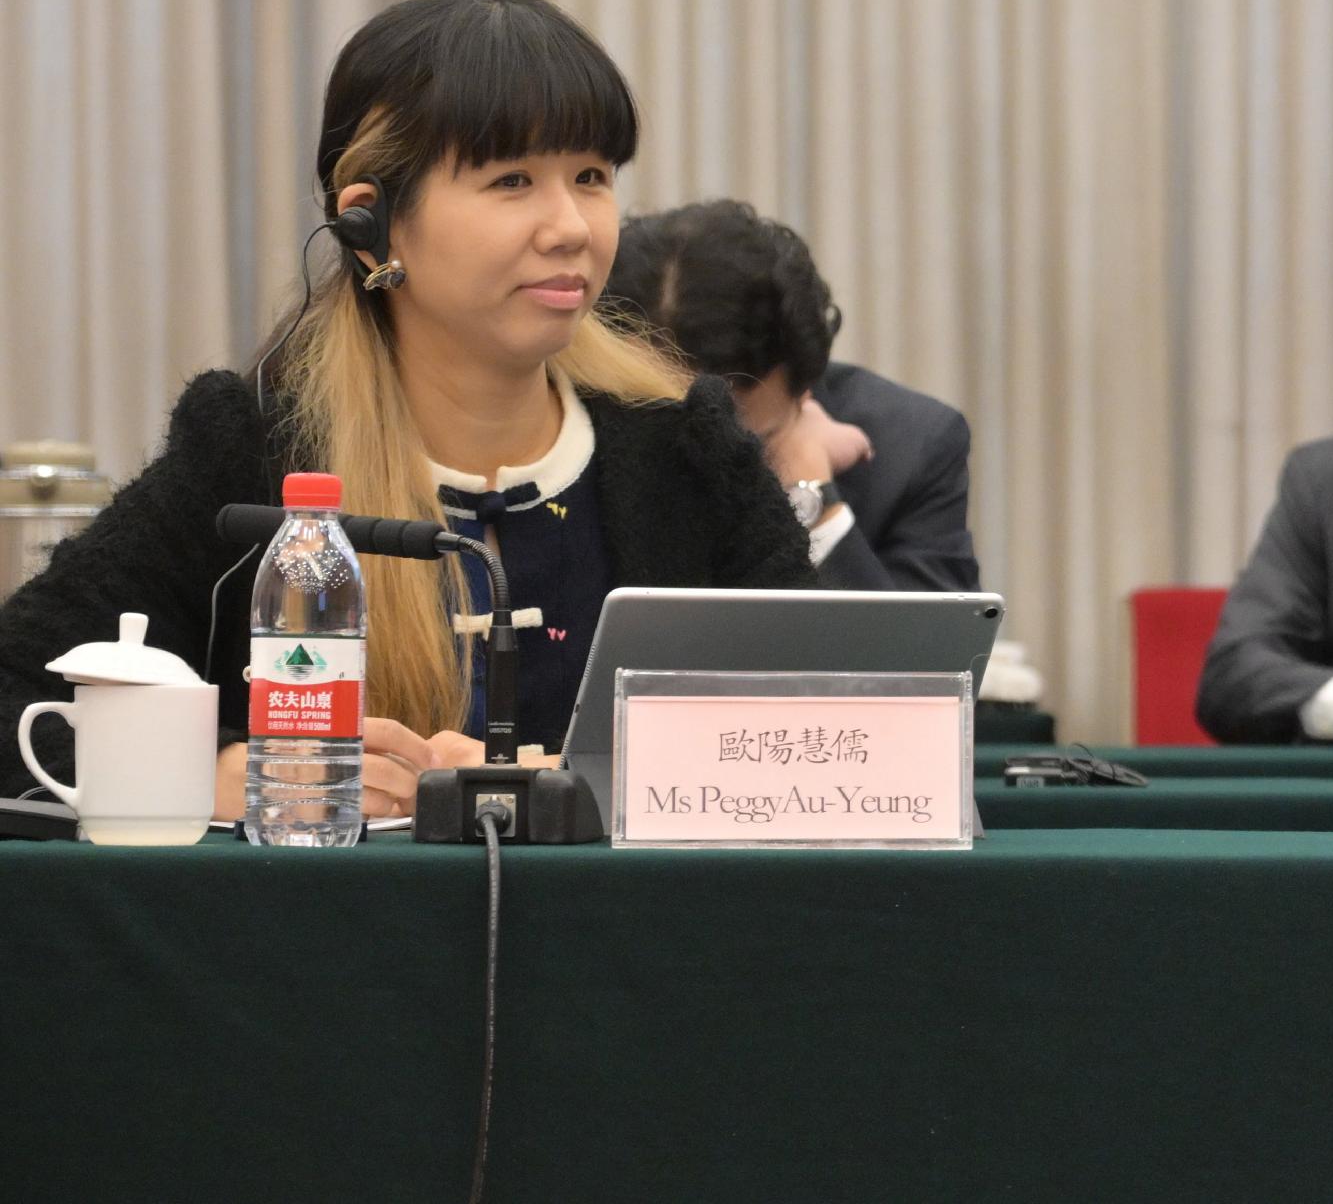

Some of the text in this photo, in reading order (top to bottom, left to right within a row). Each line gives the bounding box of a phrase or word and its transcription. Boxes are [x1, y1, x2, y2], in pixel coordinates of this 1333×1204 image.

[267, 690, 332, 709] 农夫山泉
[301, 711, 332, 720] SPRING
[718, 726, 869, 766] 歐陽慧儒
[645, 786, 692, 814] Ms
